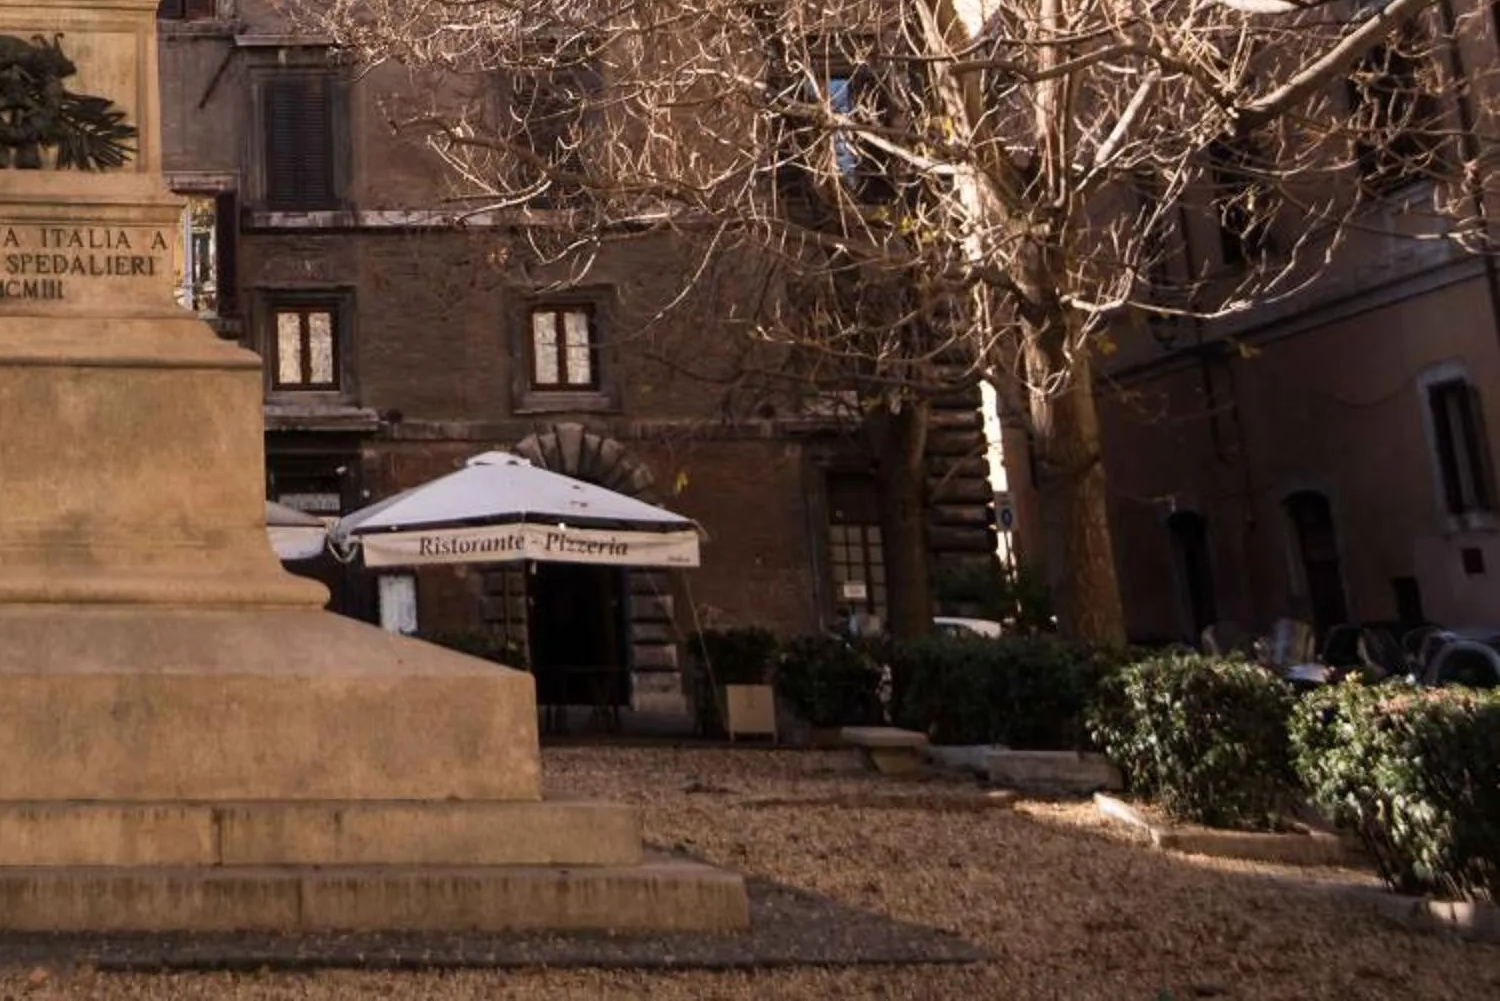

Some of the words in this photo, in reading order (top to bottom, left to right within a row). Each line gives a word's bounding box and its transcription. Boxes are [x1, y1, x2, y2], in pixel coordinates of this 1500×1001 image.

[40, 228, 132, 250] ITALIA
[151, 231, 168, 250] A
[5, 254, 157, 276] SPEDALIERI
[418, 534, 525, 557] Ristorante
[545, 532, 629, 556] Pizzeria
